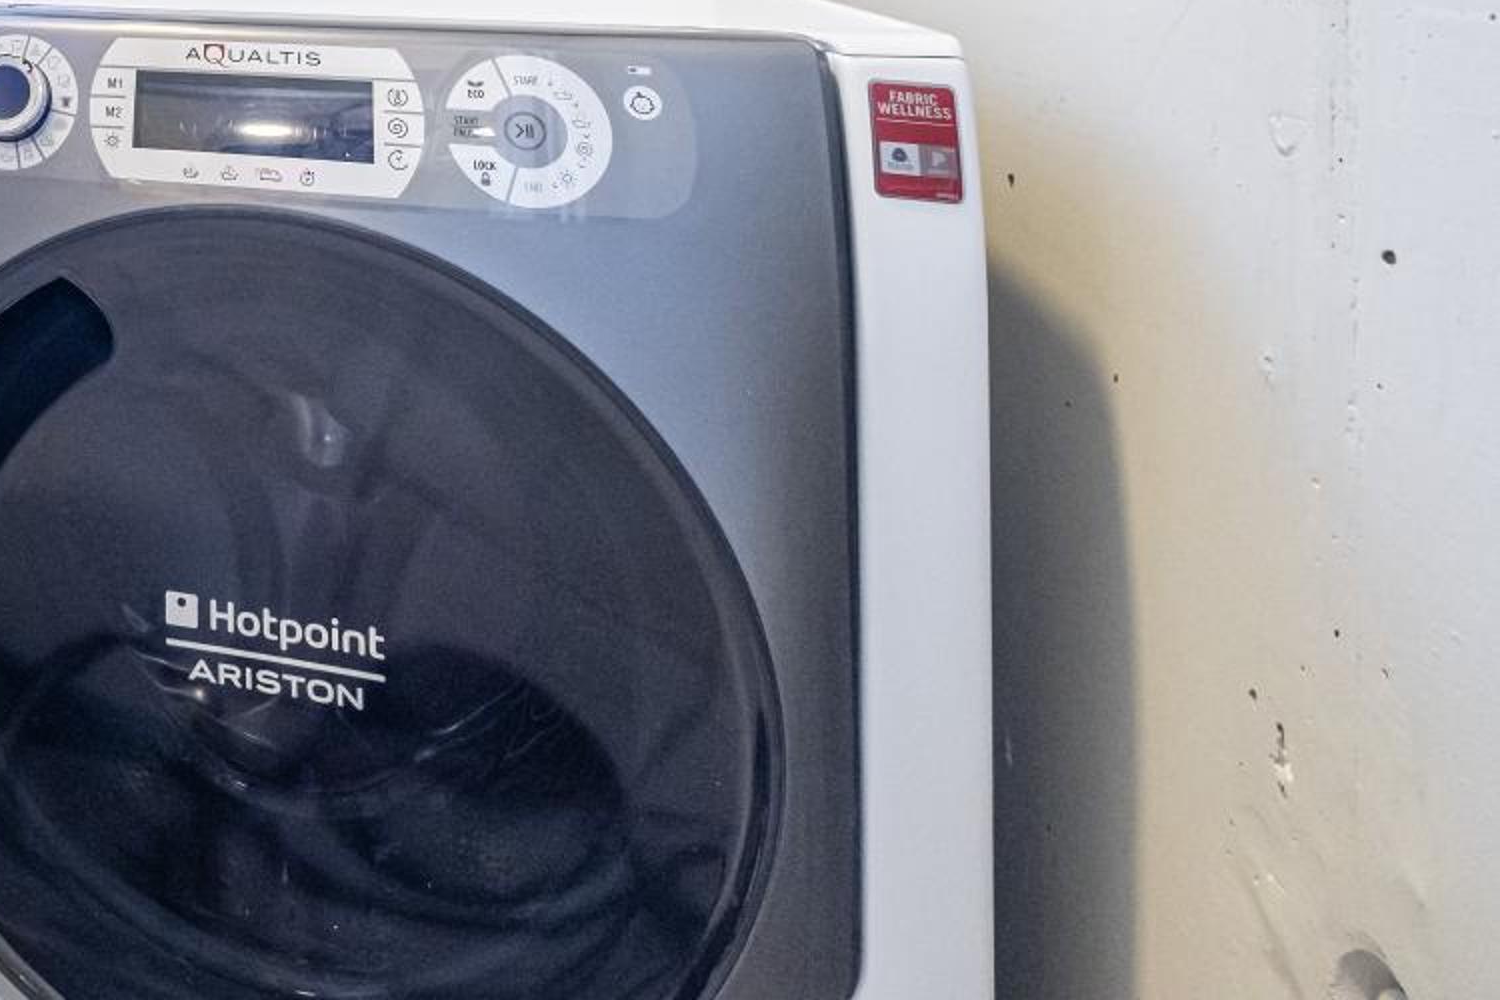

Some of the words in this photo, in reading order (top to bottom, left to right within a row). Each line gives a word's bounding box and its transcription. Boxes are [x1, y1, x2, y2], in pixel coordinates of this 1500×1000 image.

[185, 43, 321, 66] AQUALTIS
[108, 76, 123, 89] M1
[889, 90, 937, 107] FABRIC
[106, 106, 123, 120] M2
[877, 103, 952, 121] WELLNESS
[474, 160, 496, 171] LOCK
[209, 599, 385, 661] Hotpoint
[189, 659, 364, 711] ARISTON
